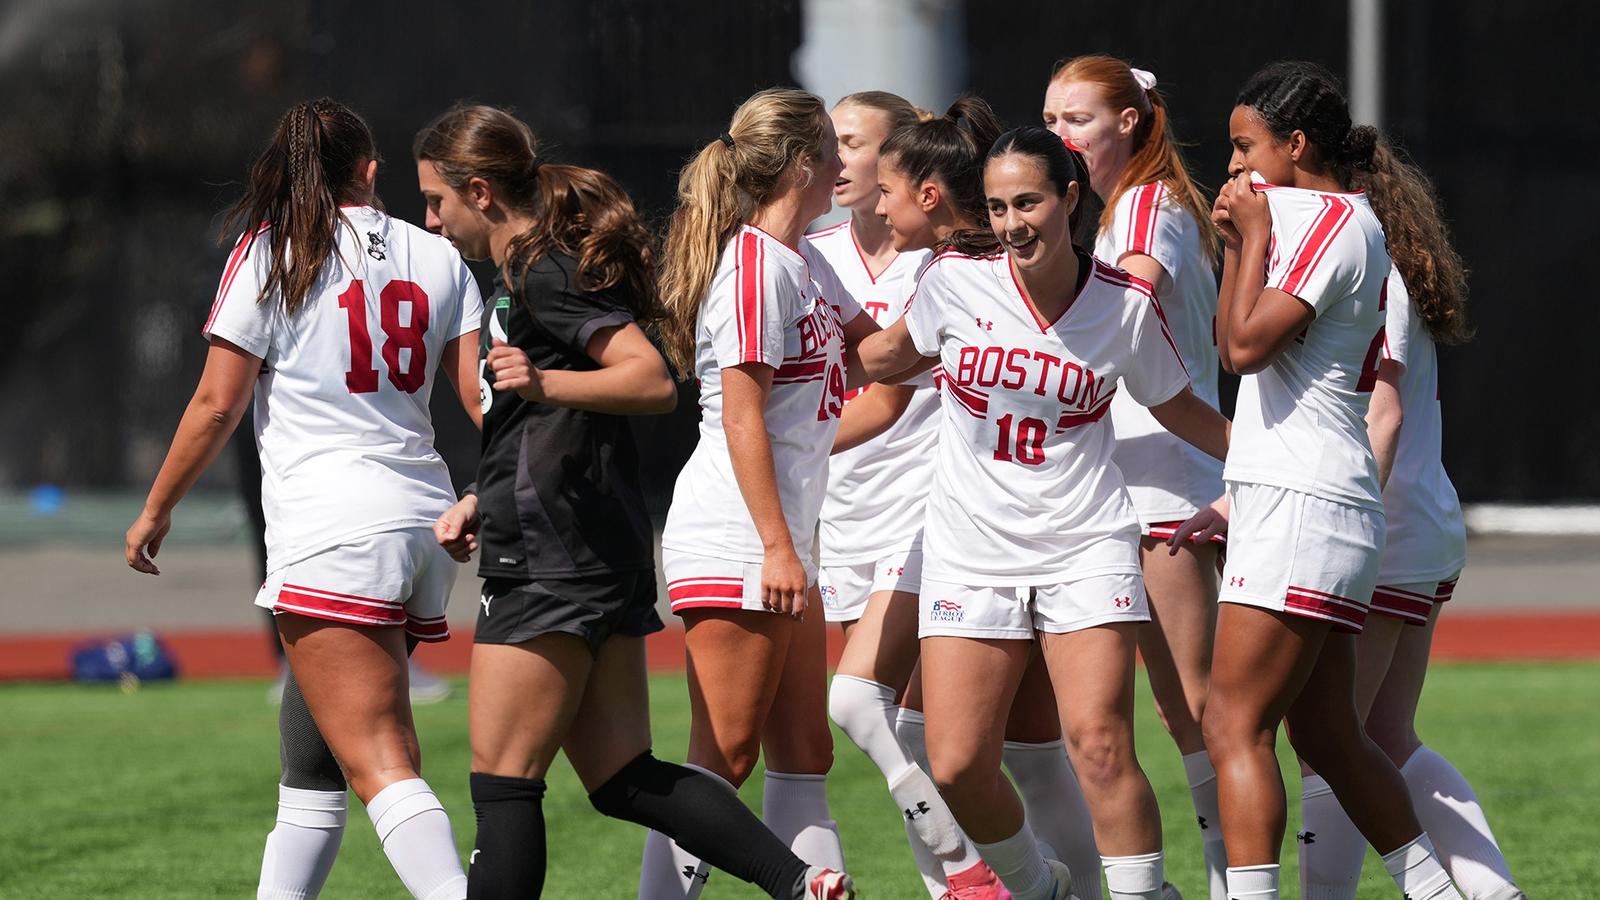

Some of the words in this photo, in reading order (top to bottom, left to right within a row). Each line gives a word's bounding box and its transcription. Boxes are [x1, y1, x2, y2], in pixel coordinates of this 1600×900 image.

[338, 279, 429, 394] 18
[817, 363, 845, 421] 19
[957, 347, 1104, 412] BOSTON
[993, 413, 1048, 465] 10
